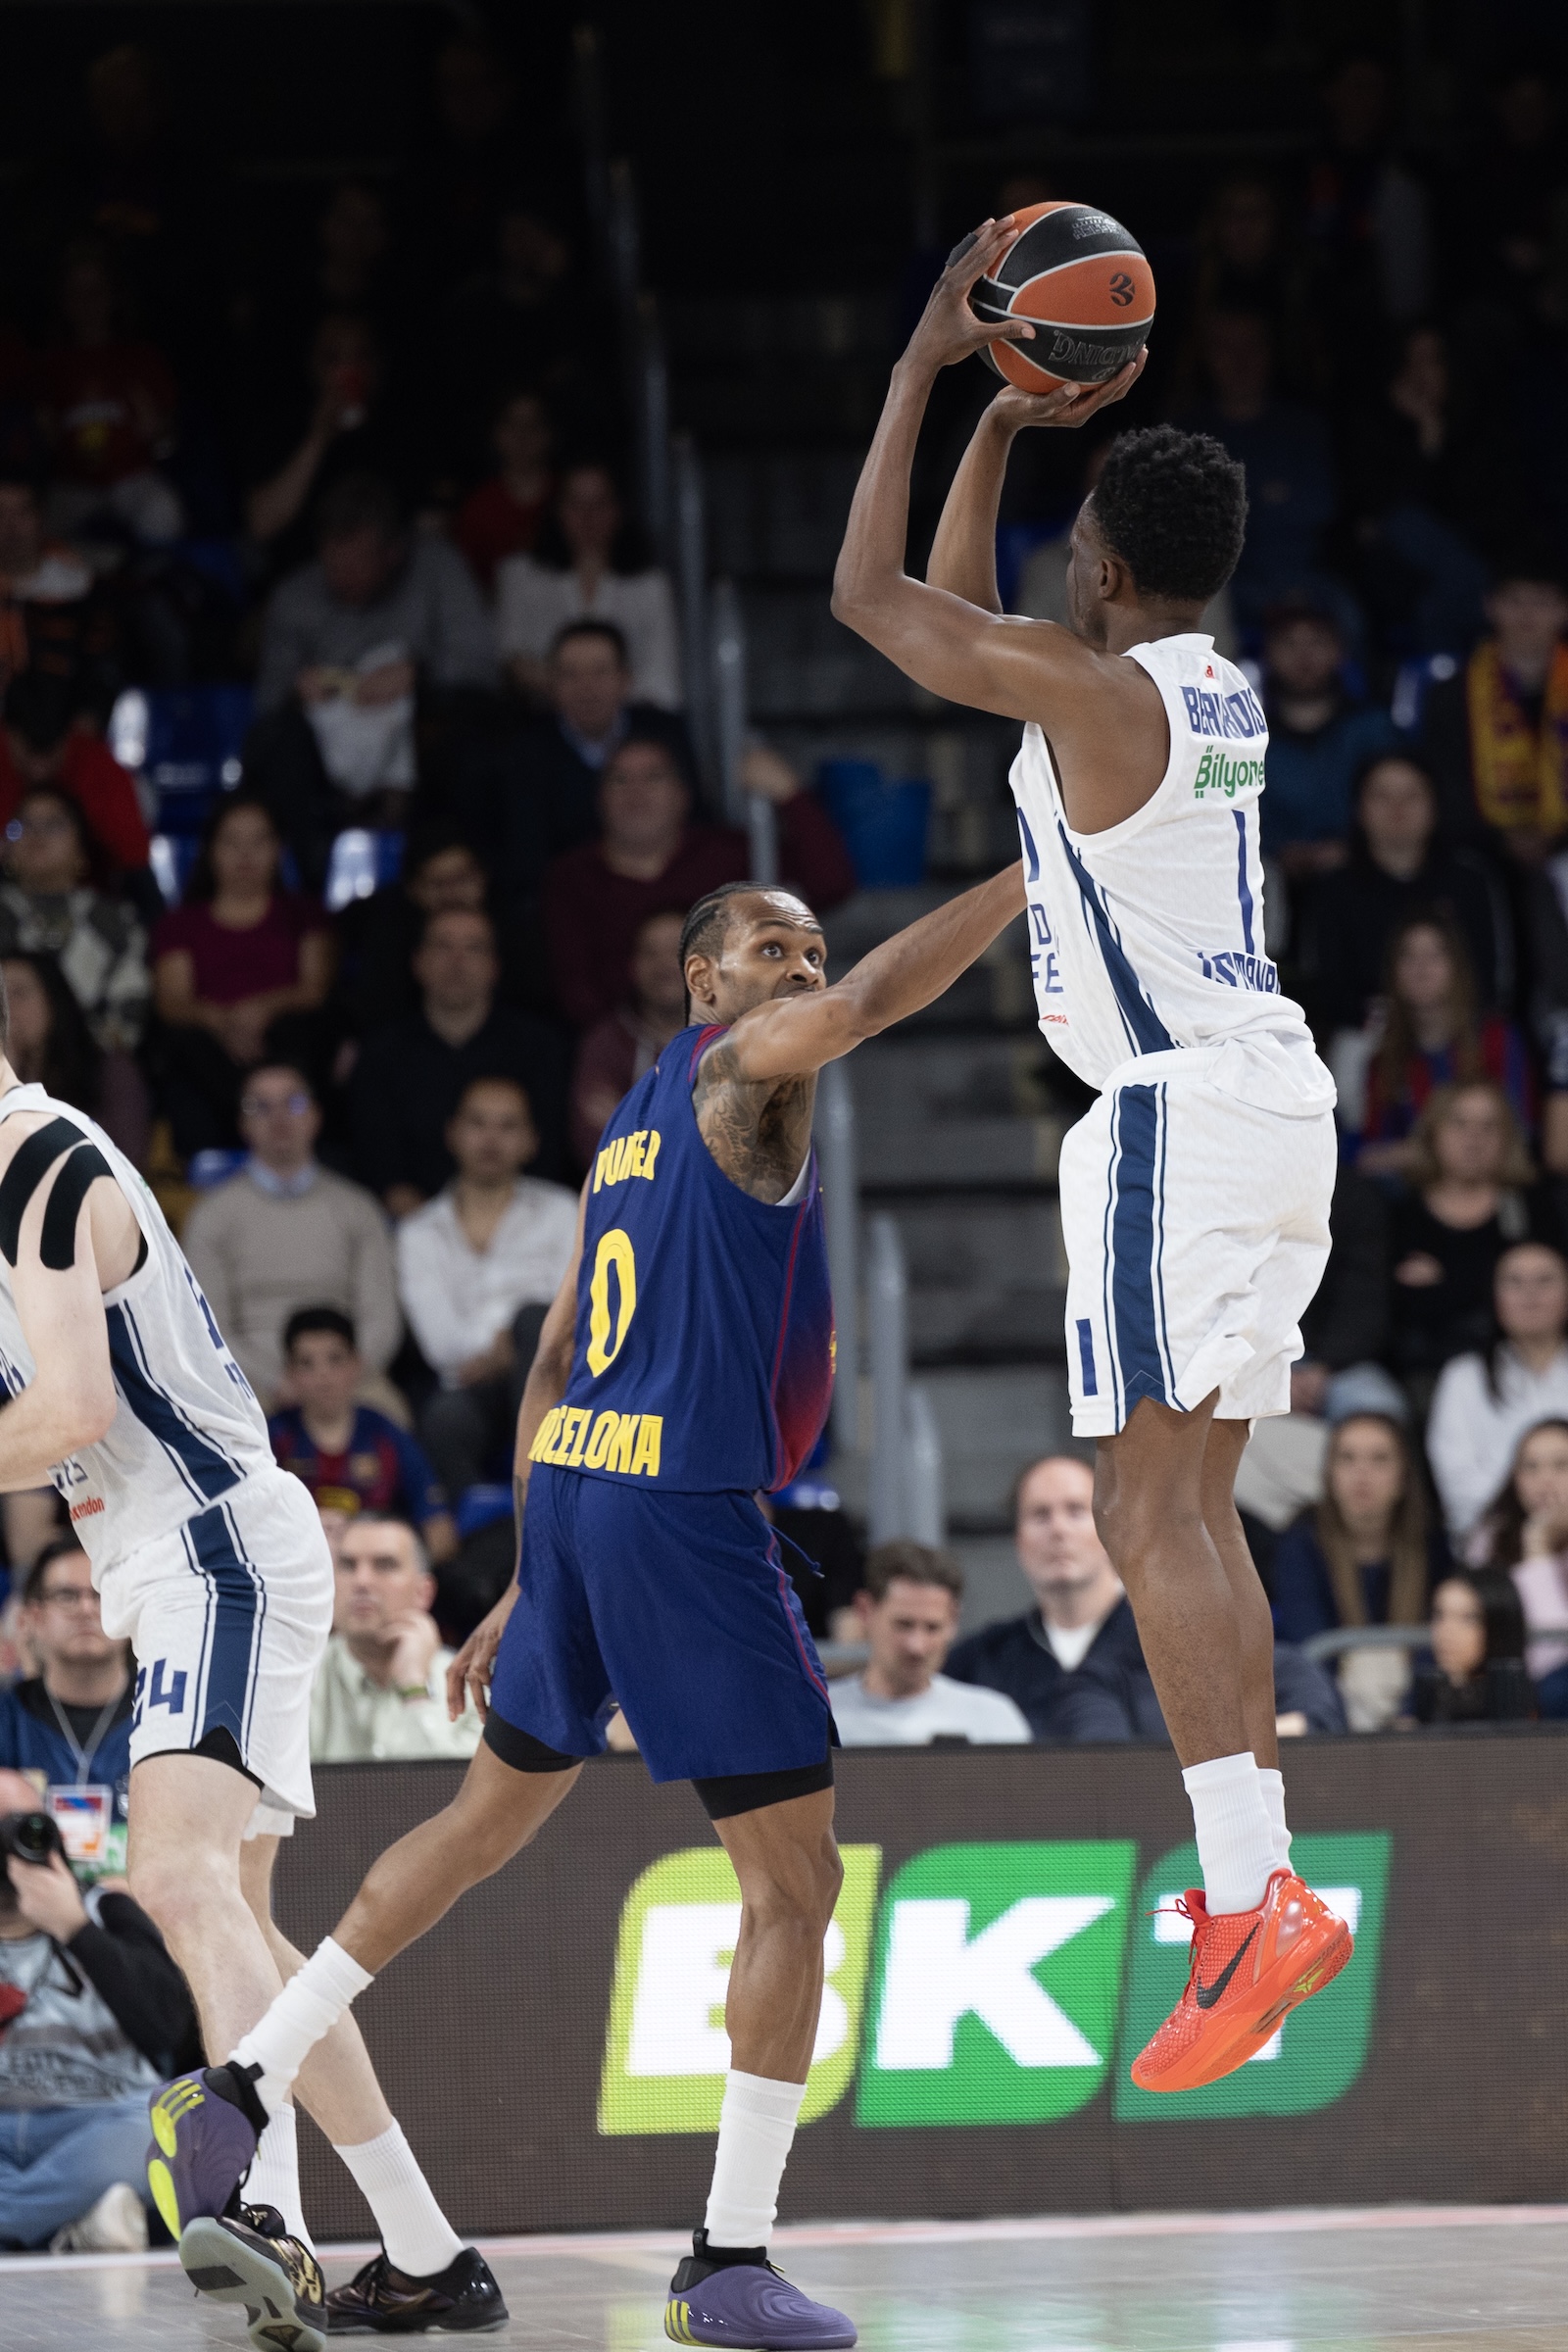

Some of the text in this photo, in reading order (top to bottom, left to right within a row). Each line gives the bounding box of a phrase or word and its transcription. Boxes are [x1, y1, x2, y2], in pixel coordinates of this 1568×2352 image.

[1049, 331, 1139, 365] ALDING
[1194, 746, 1264, 799] Bilyone
[1231, 809, 1254, 956] 1
[587, 1229, 636, 1378] 0
[1075, 1318, 1099, 1396] 1
